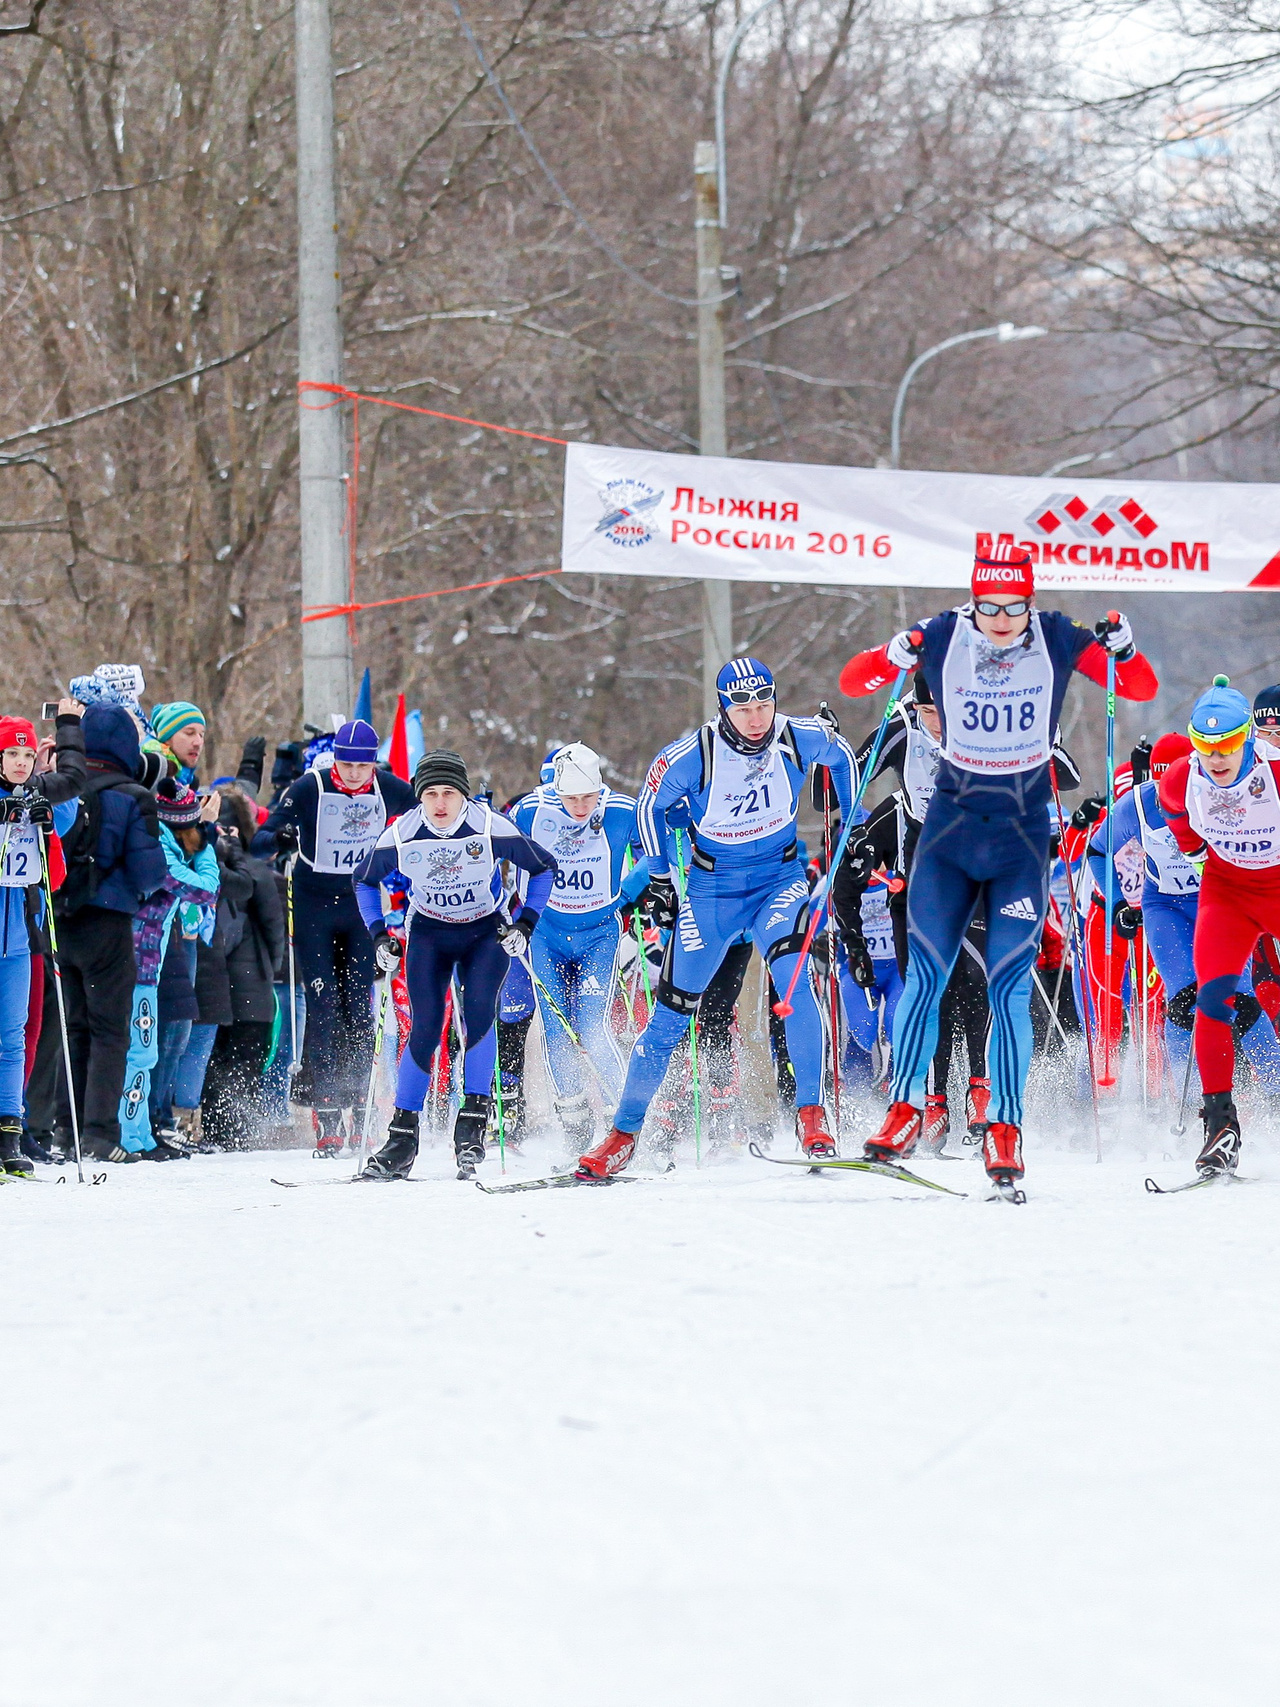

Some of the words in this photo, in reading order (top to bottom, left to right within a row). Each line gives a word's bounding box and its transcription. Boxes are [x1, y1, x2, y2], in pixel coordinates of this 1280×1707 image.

[671, 487, 800, 523] Лыжня
[670, 519, 797, 552] России
[806, 531, 893, 558] 2016
[976, 567, 1026, 583] LUKOIL
[726, 675, 768, 692] LUKOIL
[976, 675, 1012, 688] РОССИИ
[964, 685, 1043, 700] спортмастер
[962, 700, 1036, 733] 3018
[984, 758, 1021, 768] РОССИИ
[1153, 762, 1171, 773] VITA
[734, 825, 764, 838] РОССИИ
[553, 846, 581, 857] РОССИИ
[554, 868, 595, 891] 840
[1173, 874, 1199, 891] 14
[1000, 905, 1038, 922] adidas
[891, 1112, 921, 1146] alpina
